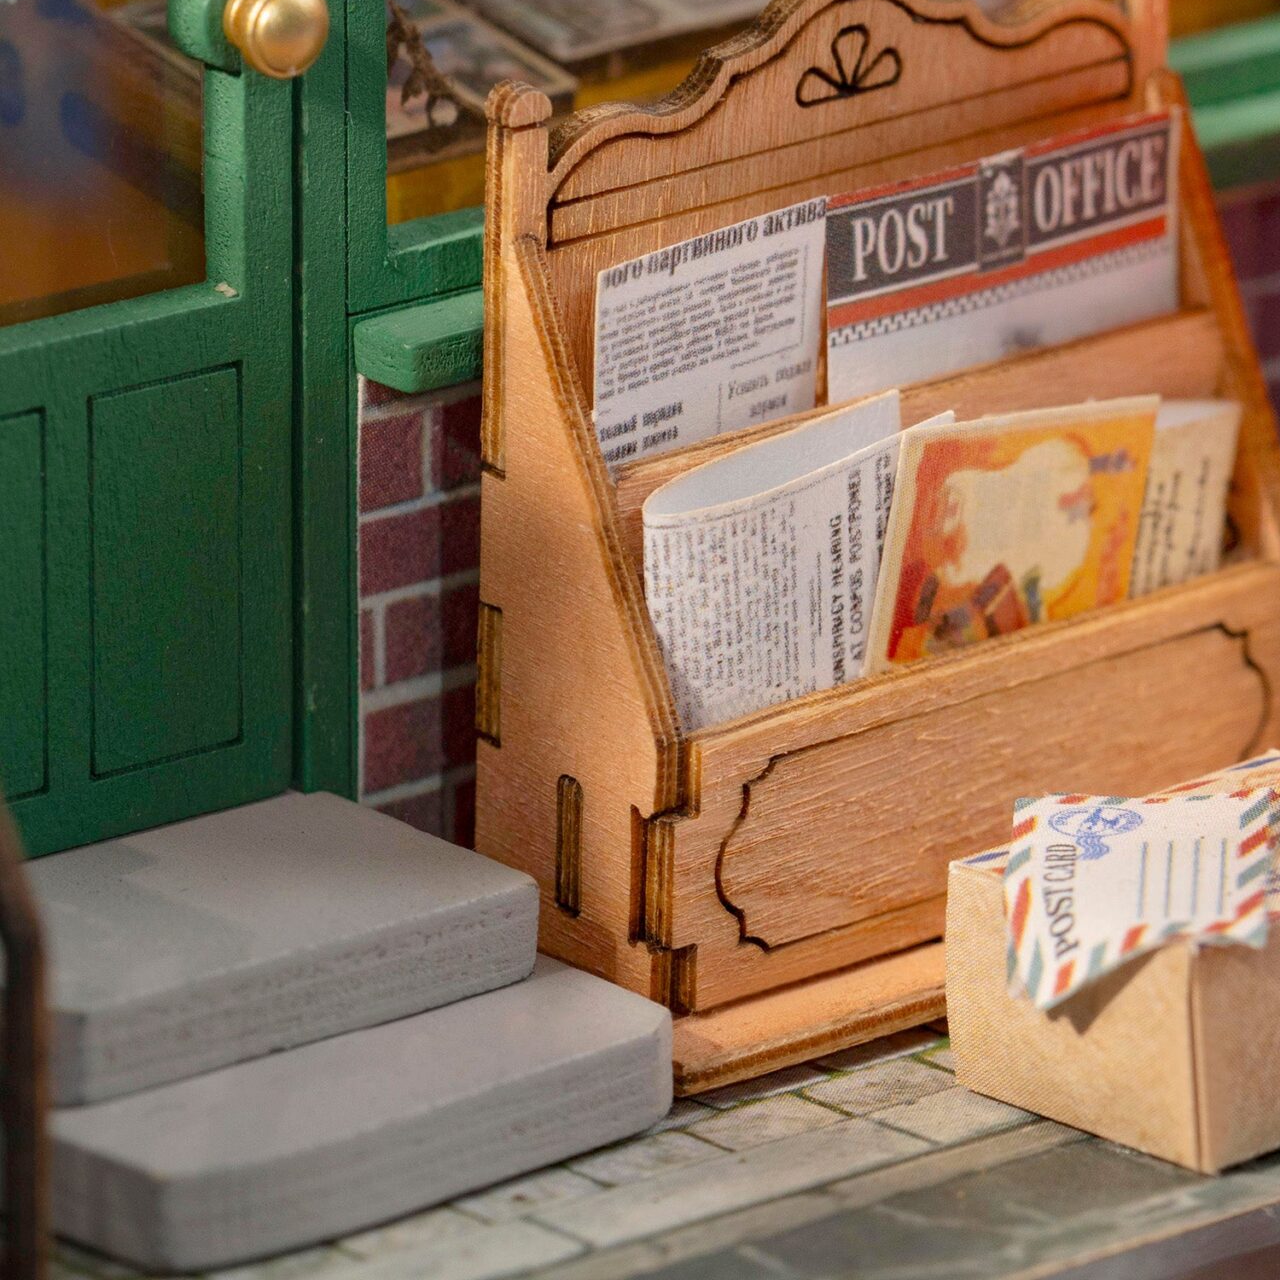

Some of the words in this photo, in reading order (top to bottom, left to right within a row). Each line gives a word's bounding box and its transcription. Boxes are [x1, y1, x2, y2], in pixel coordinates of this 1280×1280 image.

[851, 195, 954, 282] POST
[1034, 133, 1168, 233] OFFICE
[829, 515, 844, 587] HEARING
[1043, 843, 1077, 882] CARD
[1042, 886, 1080, 958] POST
